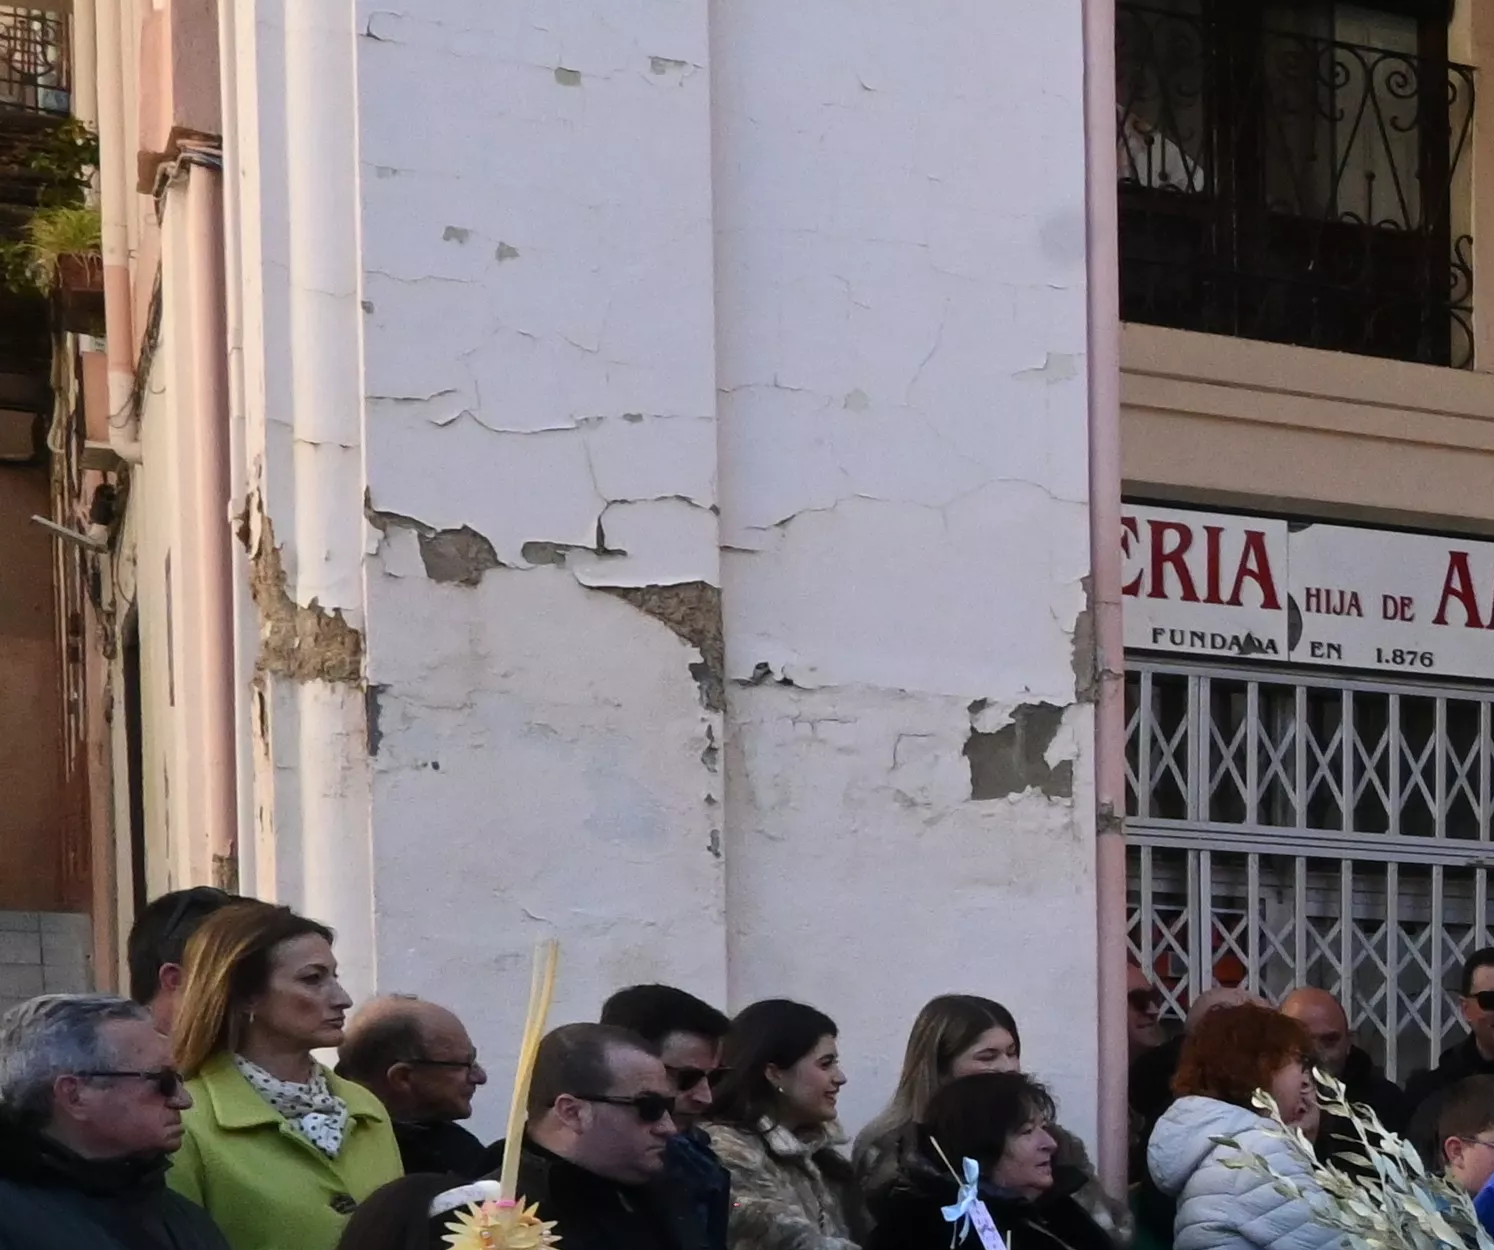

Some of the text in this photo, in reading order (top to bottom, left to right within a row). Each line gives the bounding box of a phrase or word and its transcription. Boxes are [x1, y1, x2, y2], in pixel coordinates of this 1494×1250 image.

[1305, 586, 1364, 618] HIJA
[1382, 594, 1416, 622] DE
[1310, 641, 1343, 660] EN
[1376, 647, 1434, 667] 1.876
